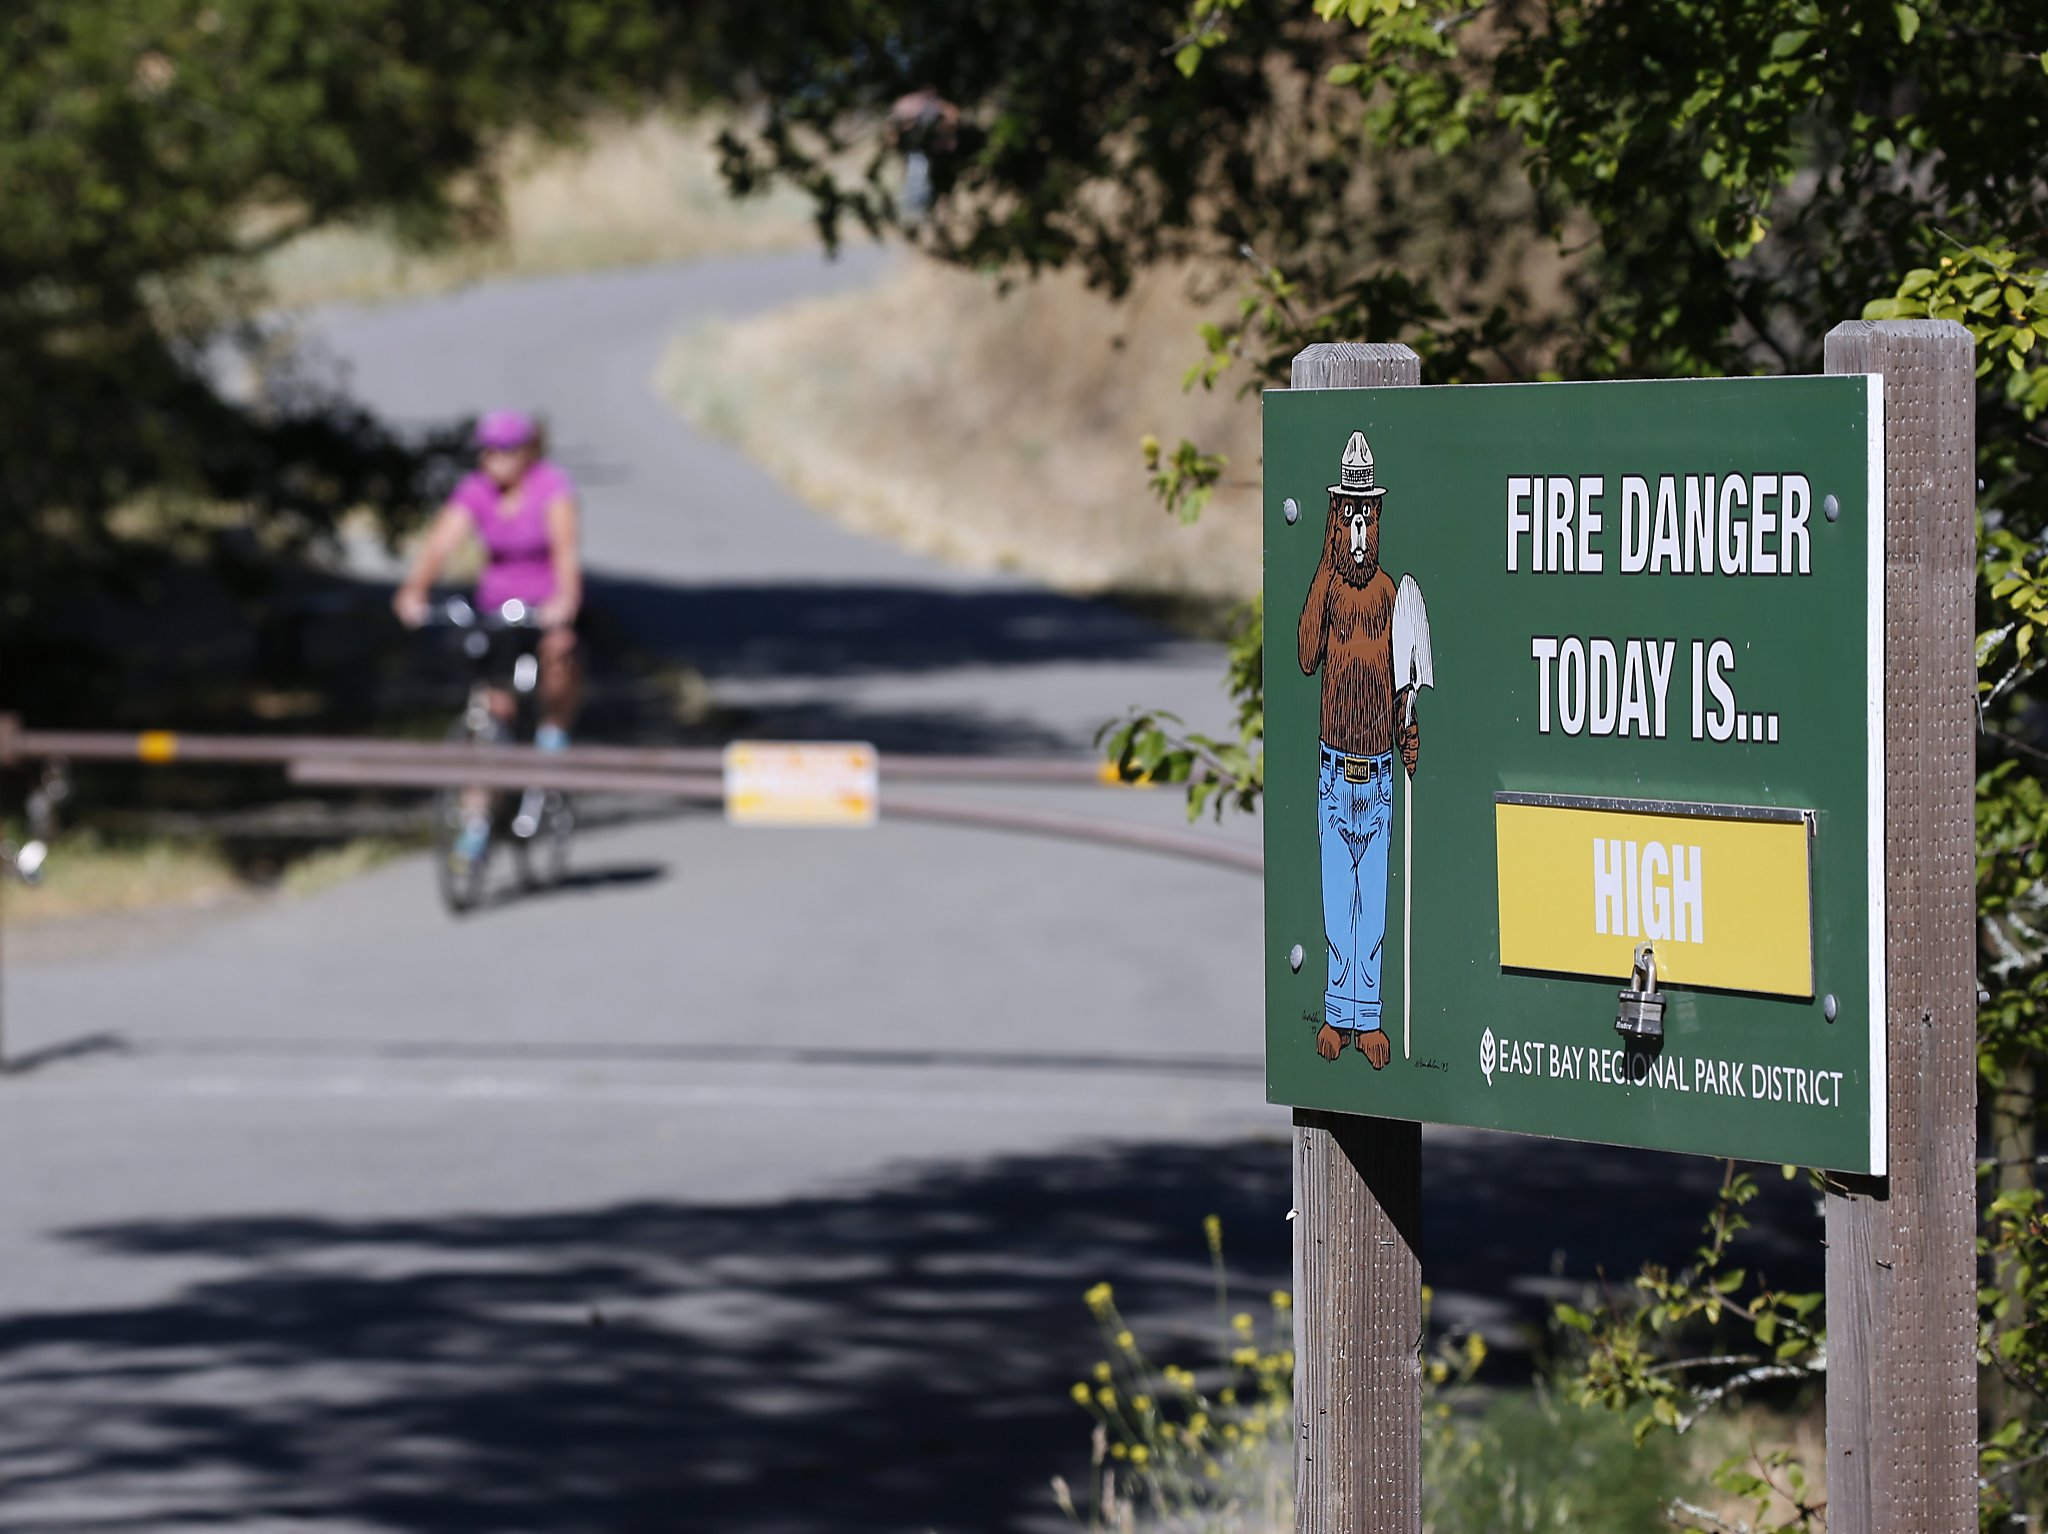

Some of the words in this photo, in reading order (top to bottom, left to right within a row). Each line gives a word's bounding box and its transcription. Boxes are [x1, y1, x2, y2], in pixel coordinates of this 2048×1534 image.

[1506, 473, 1605, 574] FIRE
[1619, 472, 1812, 576] DANGER
[1531, 636, 1677, 738] TODAY
[1691, 640, 1780, 744] IS...
[1592, 836, 1706, 945] HIGH
[1499, 1038, 1545, 1076] EAST
[1549, 1043, 1585, 1080] BAY
[1588, 1047, 1690, 1092] REGIONAL
[1694, 1057, 1747, 1098] PARK
[1751, 1063, 1844, 1108] DISTRICT
